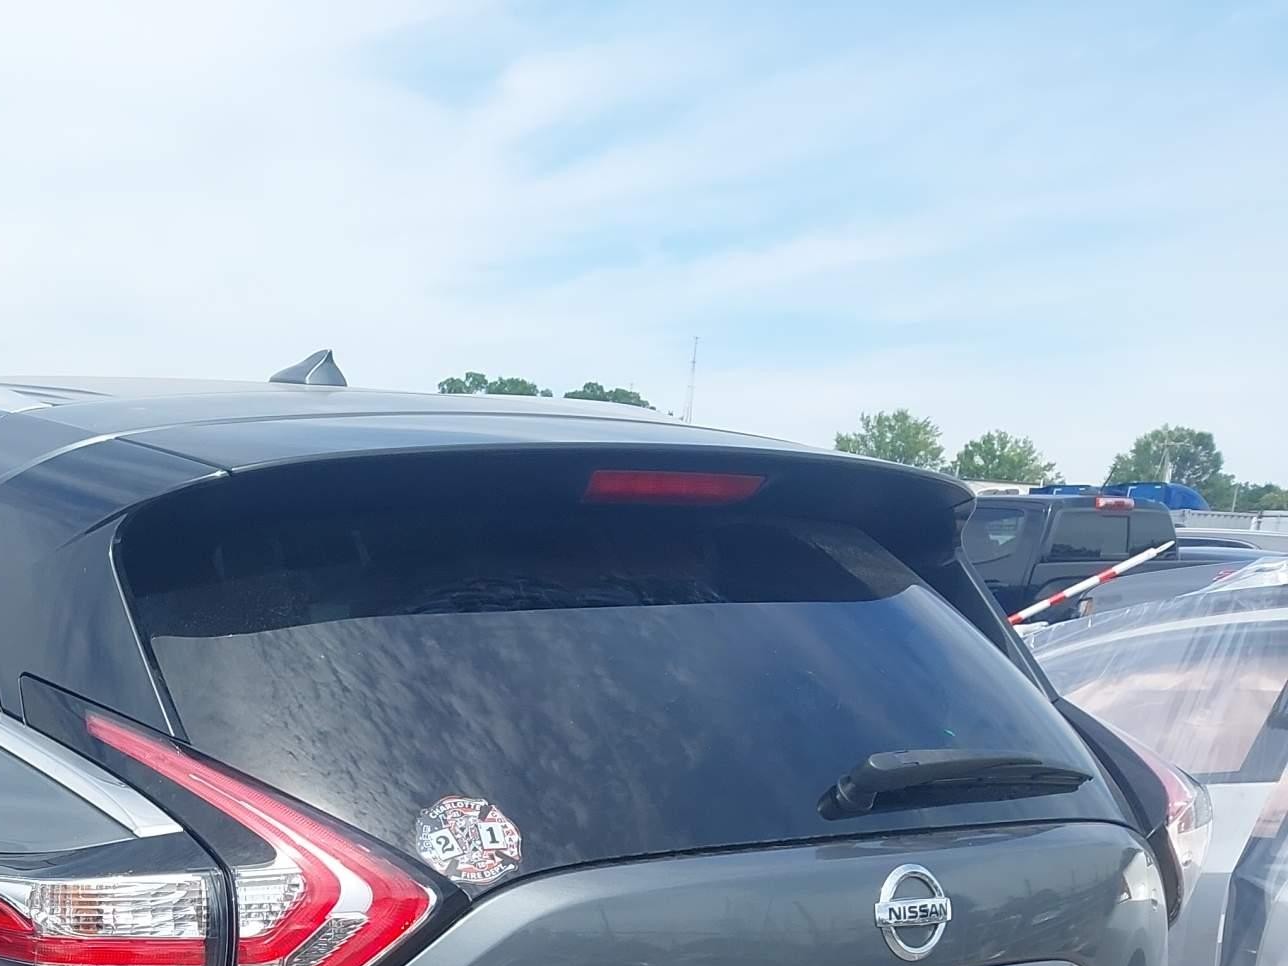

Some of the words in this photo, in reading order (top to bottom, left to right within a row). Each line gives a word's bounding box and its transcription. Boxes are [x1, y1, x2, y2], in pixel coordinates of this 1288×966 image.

[429, 801, 481, 819] CHARLOTTE
[436, 835, 455, 854] 2
[486, 826, 500, 845] 1
[461, 871, 483, 880] FIRE
[888, 902, 948, 921] NISSAN
